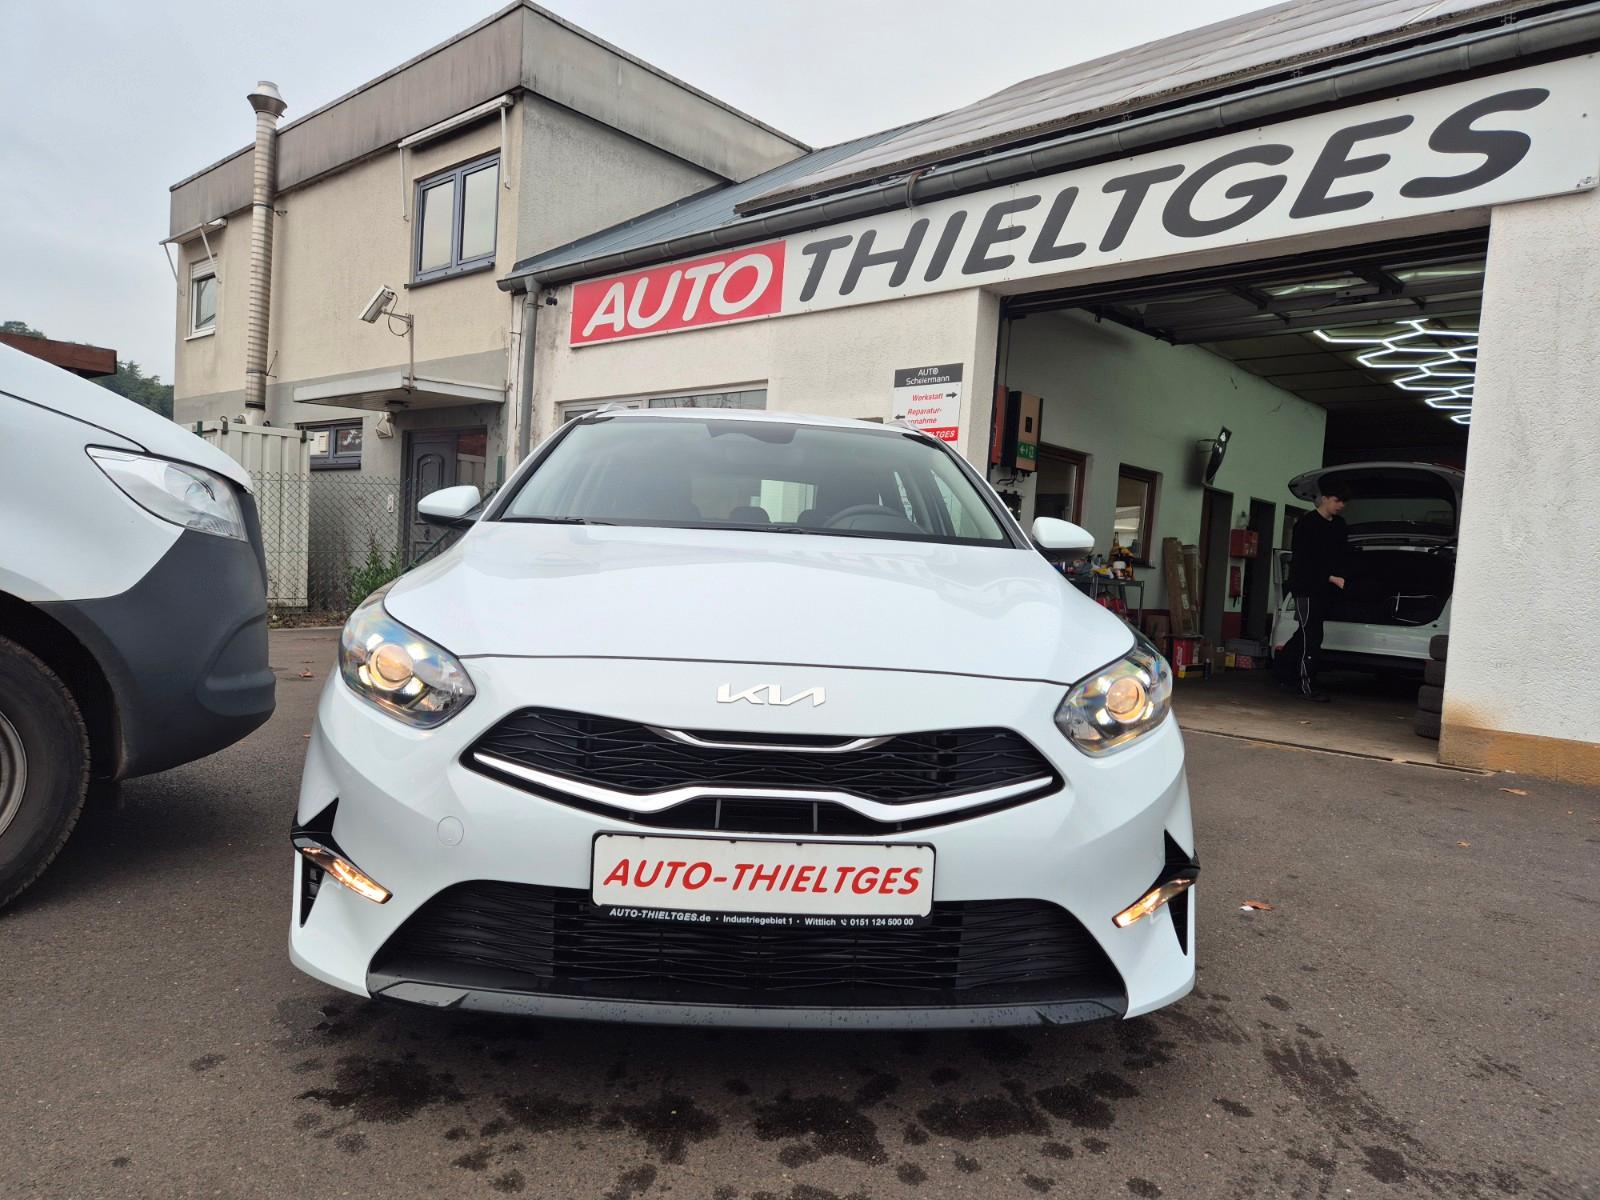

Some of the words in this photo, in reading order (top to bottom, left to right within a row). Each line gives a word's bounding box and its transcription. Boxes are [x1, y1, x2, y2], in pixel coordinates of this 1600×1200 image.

[582, 253, 774, 337] AUTO
[800, 87, 1551, 303] THIELTGES
[917, 367, 939, 377] AUTO
[716, 683, 826, 707] KIA
[603, 858, 924, 896] AUTO-THIELTGES
[609, 908, 711, 922] AUTO-THIELTGES.de
[723, 915, 786, 925] Industriegebiet
[788, 917, 793, 925] 1
[804, 917, 837, 926] Wittlich
[850, 918, 869, 926] 0151
[871, 918, 886, 926] 124
[887, 918, 901, 926] 500
[903, 918, 914, 926] 00
